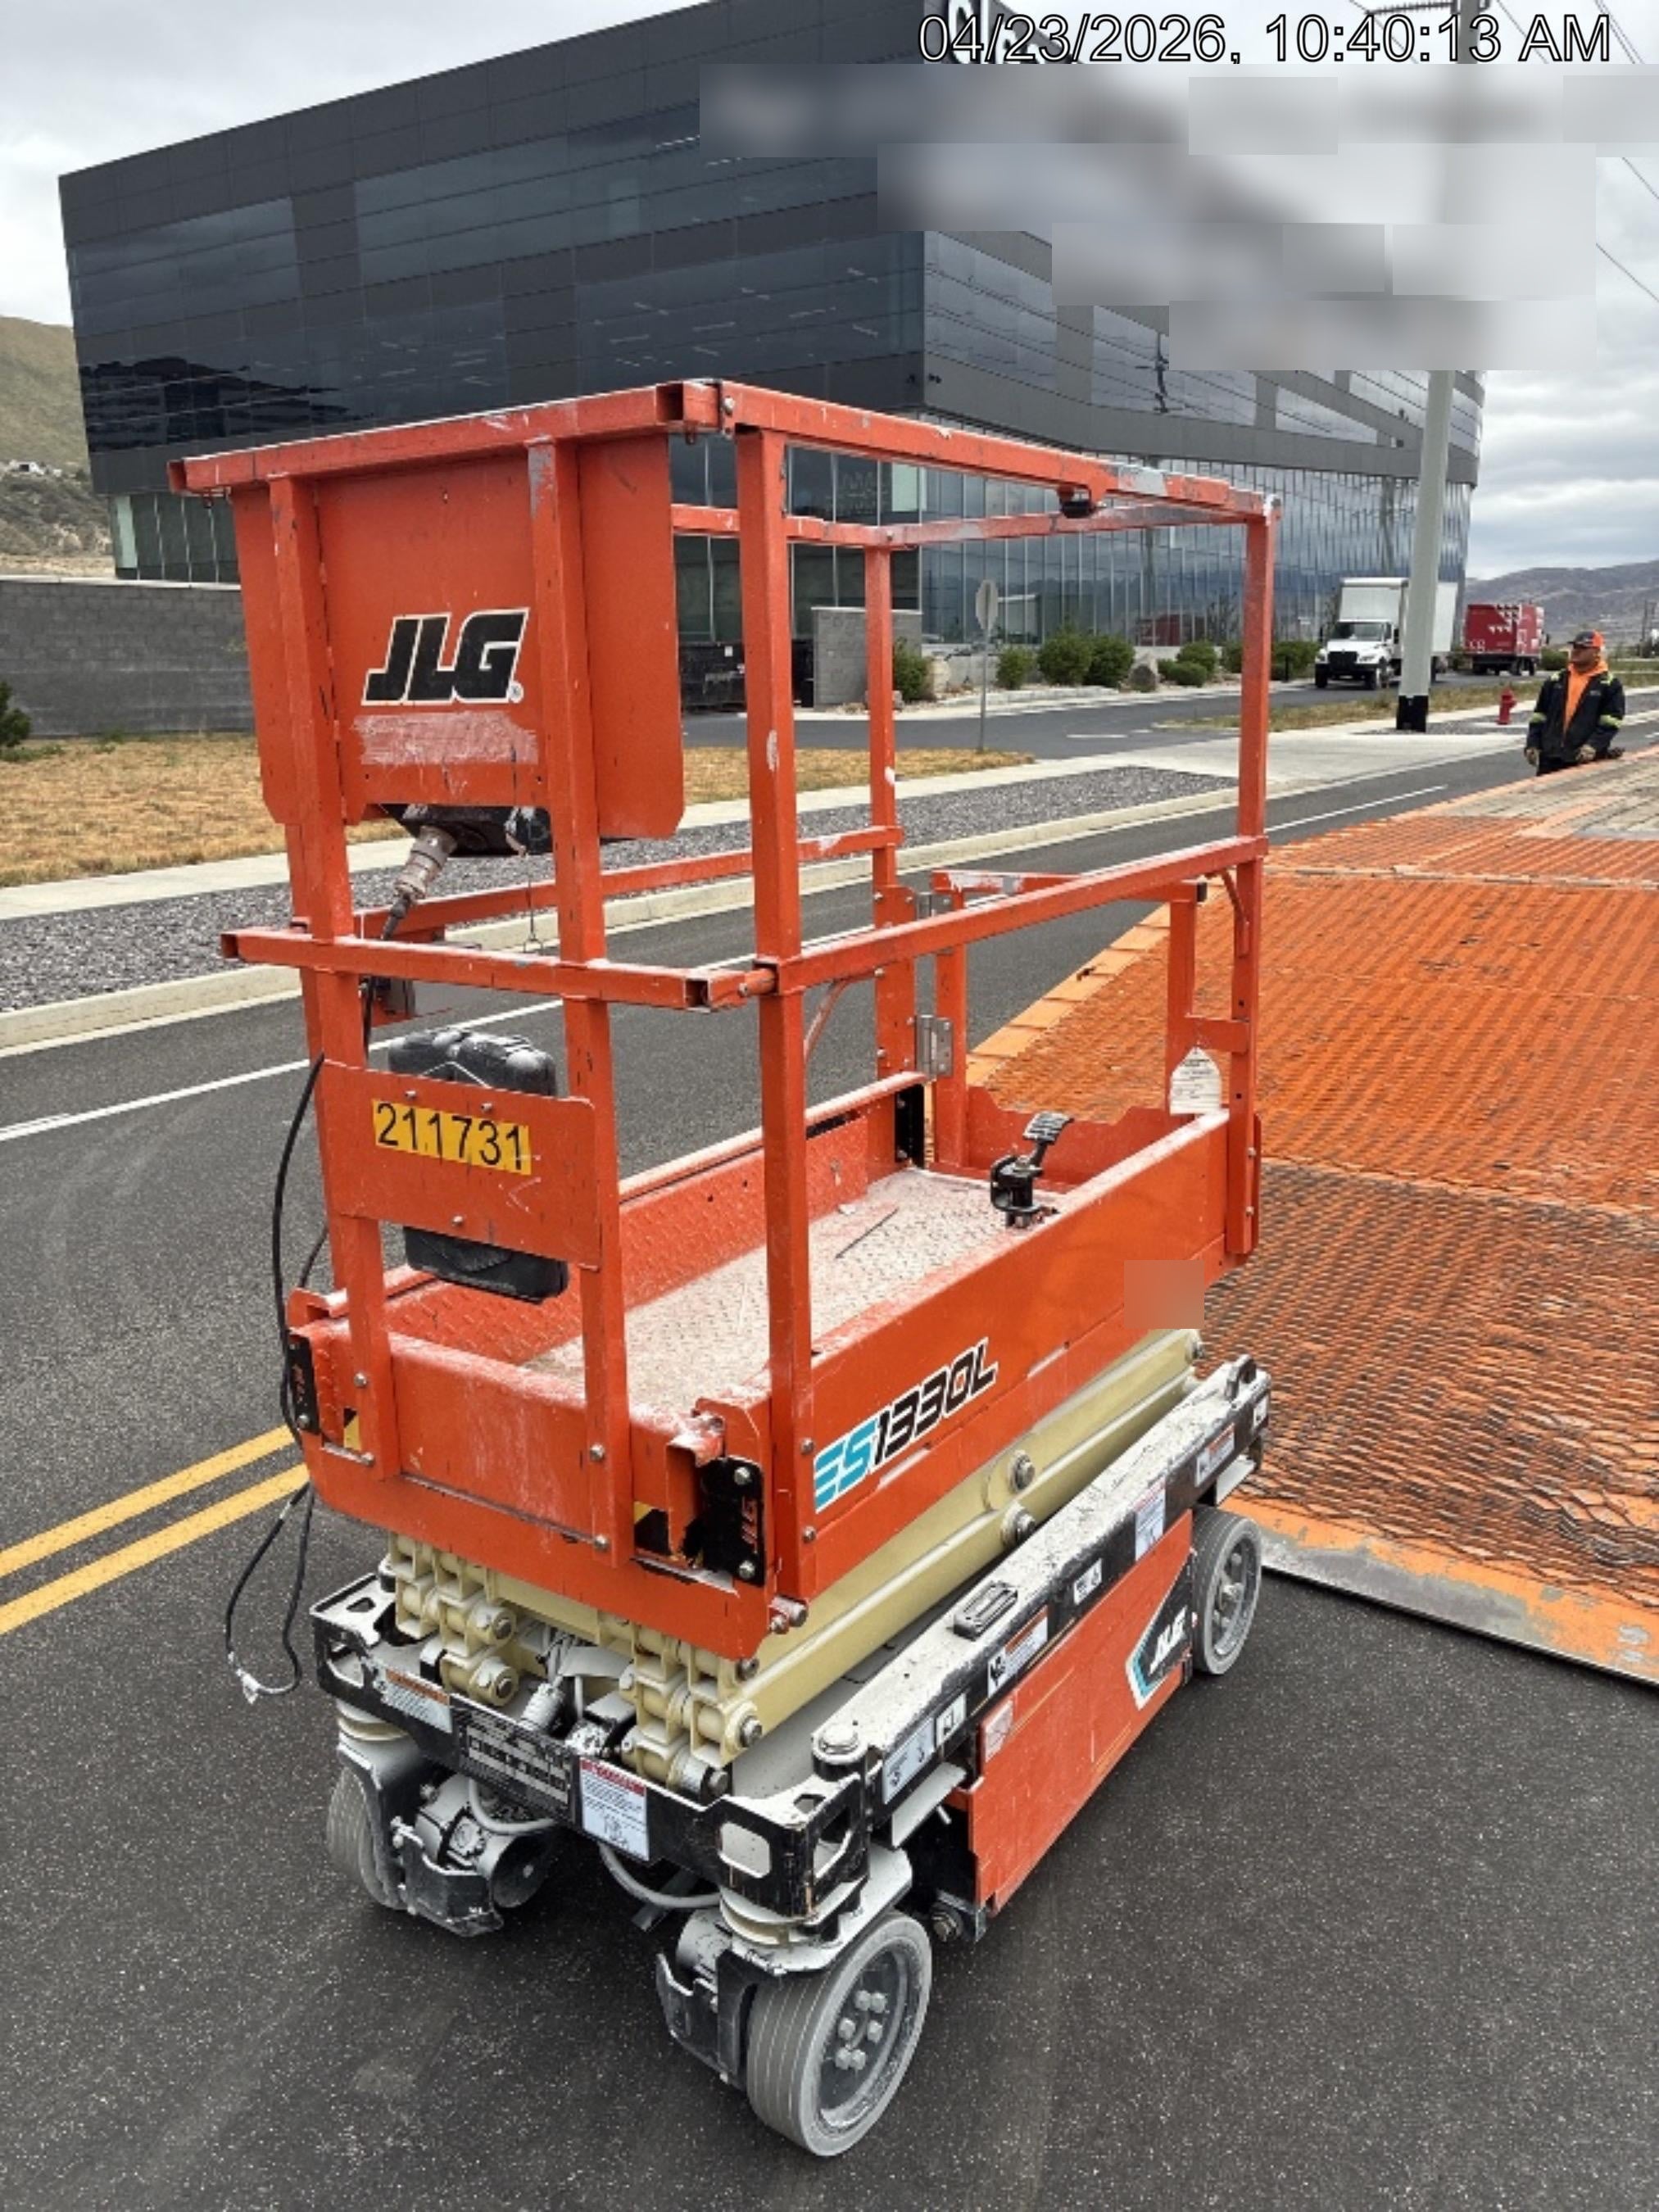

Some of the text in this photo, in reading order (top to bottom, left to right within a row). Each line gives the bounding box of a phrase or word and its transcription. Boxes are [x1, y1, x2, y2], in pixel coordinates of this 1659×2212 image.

[361, 607, 530, 706] JLG
[377, 1103, 522, 1170] 211731
[814, 1336, 999, 1514] ES1330L
